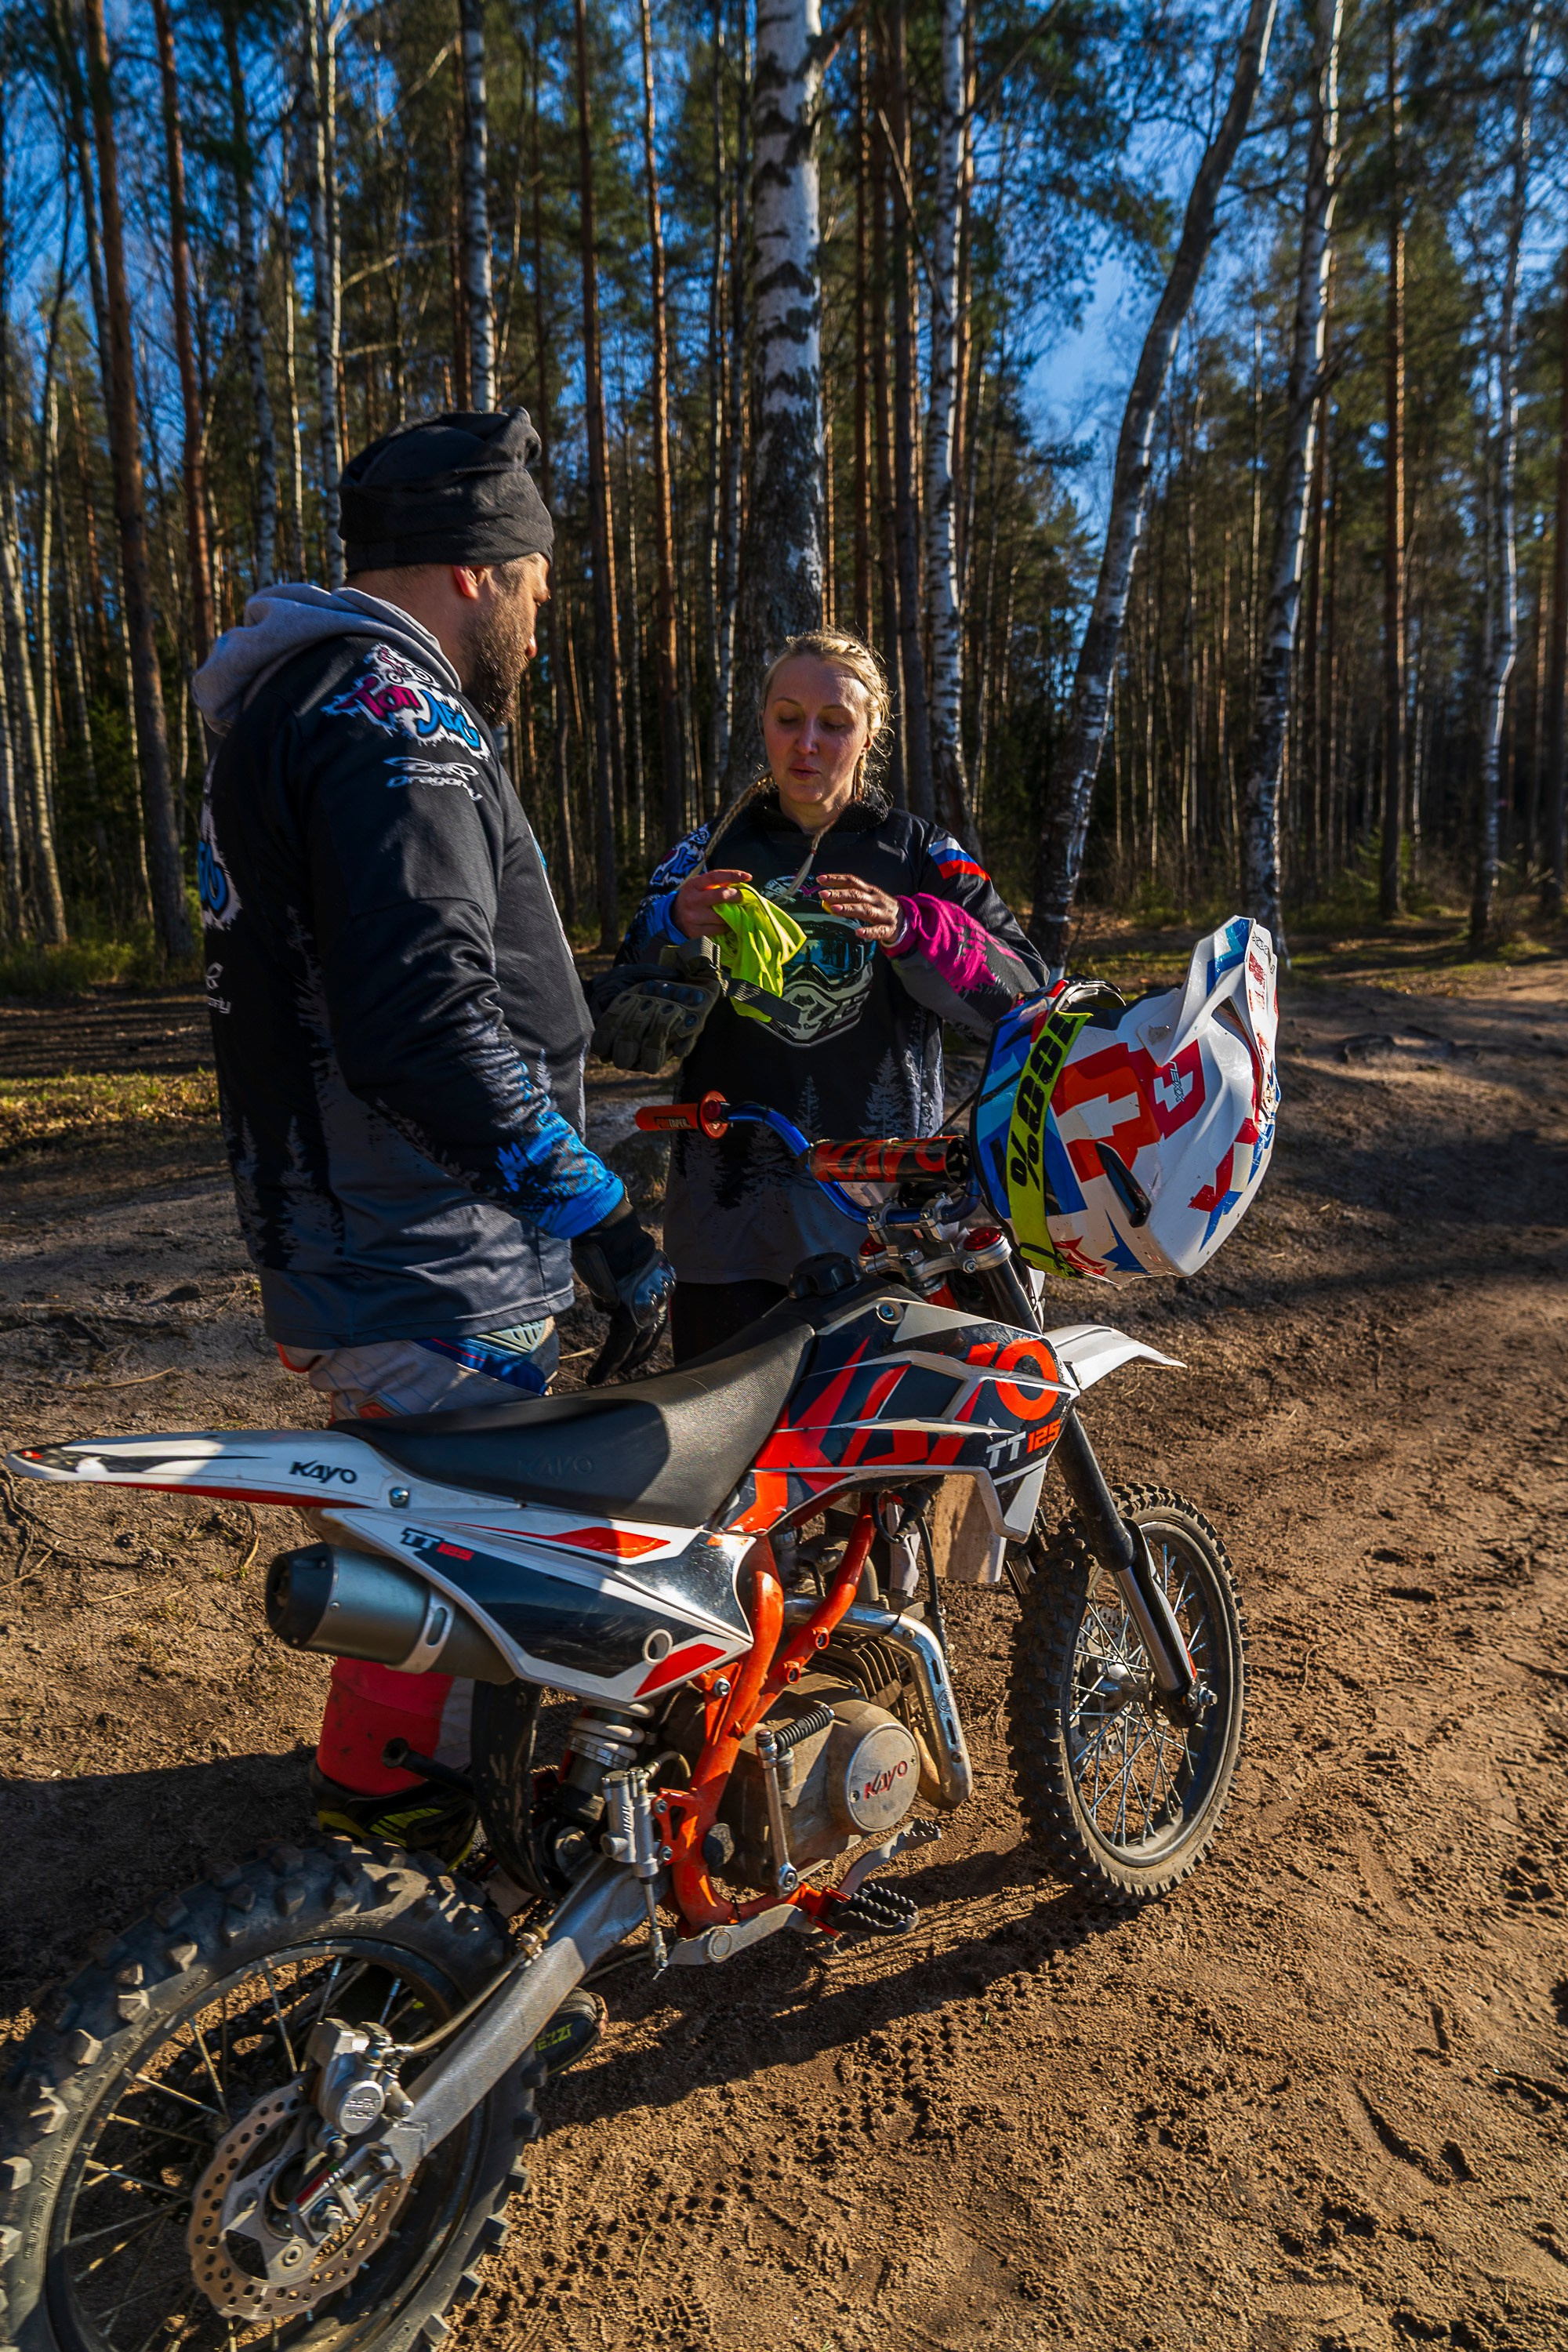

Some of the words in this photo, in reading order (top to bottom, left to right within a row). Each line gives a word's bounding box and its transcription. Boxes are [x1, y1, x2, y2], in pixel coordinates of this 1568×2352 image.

[985, 1431, 1027, 1469] TT
[1026, 1417, 1062, 1454] 125
[289, 1459, 358, 1485] KAYO
[401, 1530, 441, 1549] TT
[863, 1760, 909, 1802] KAYO
